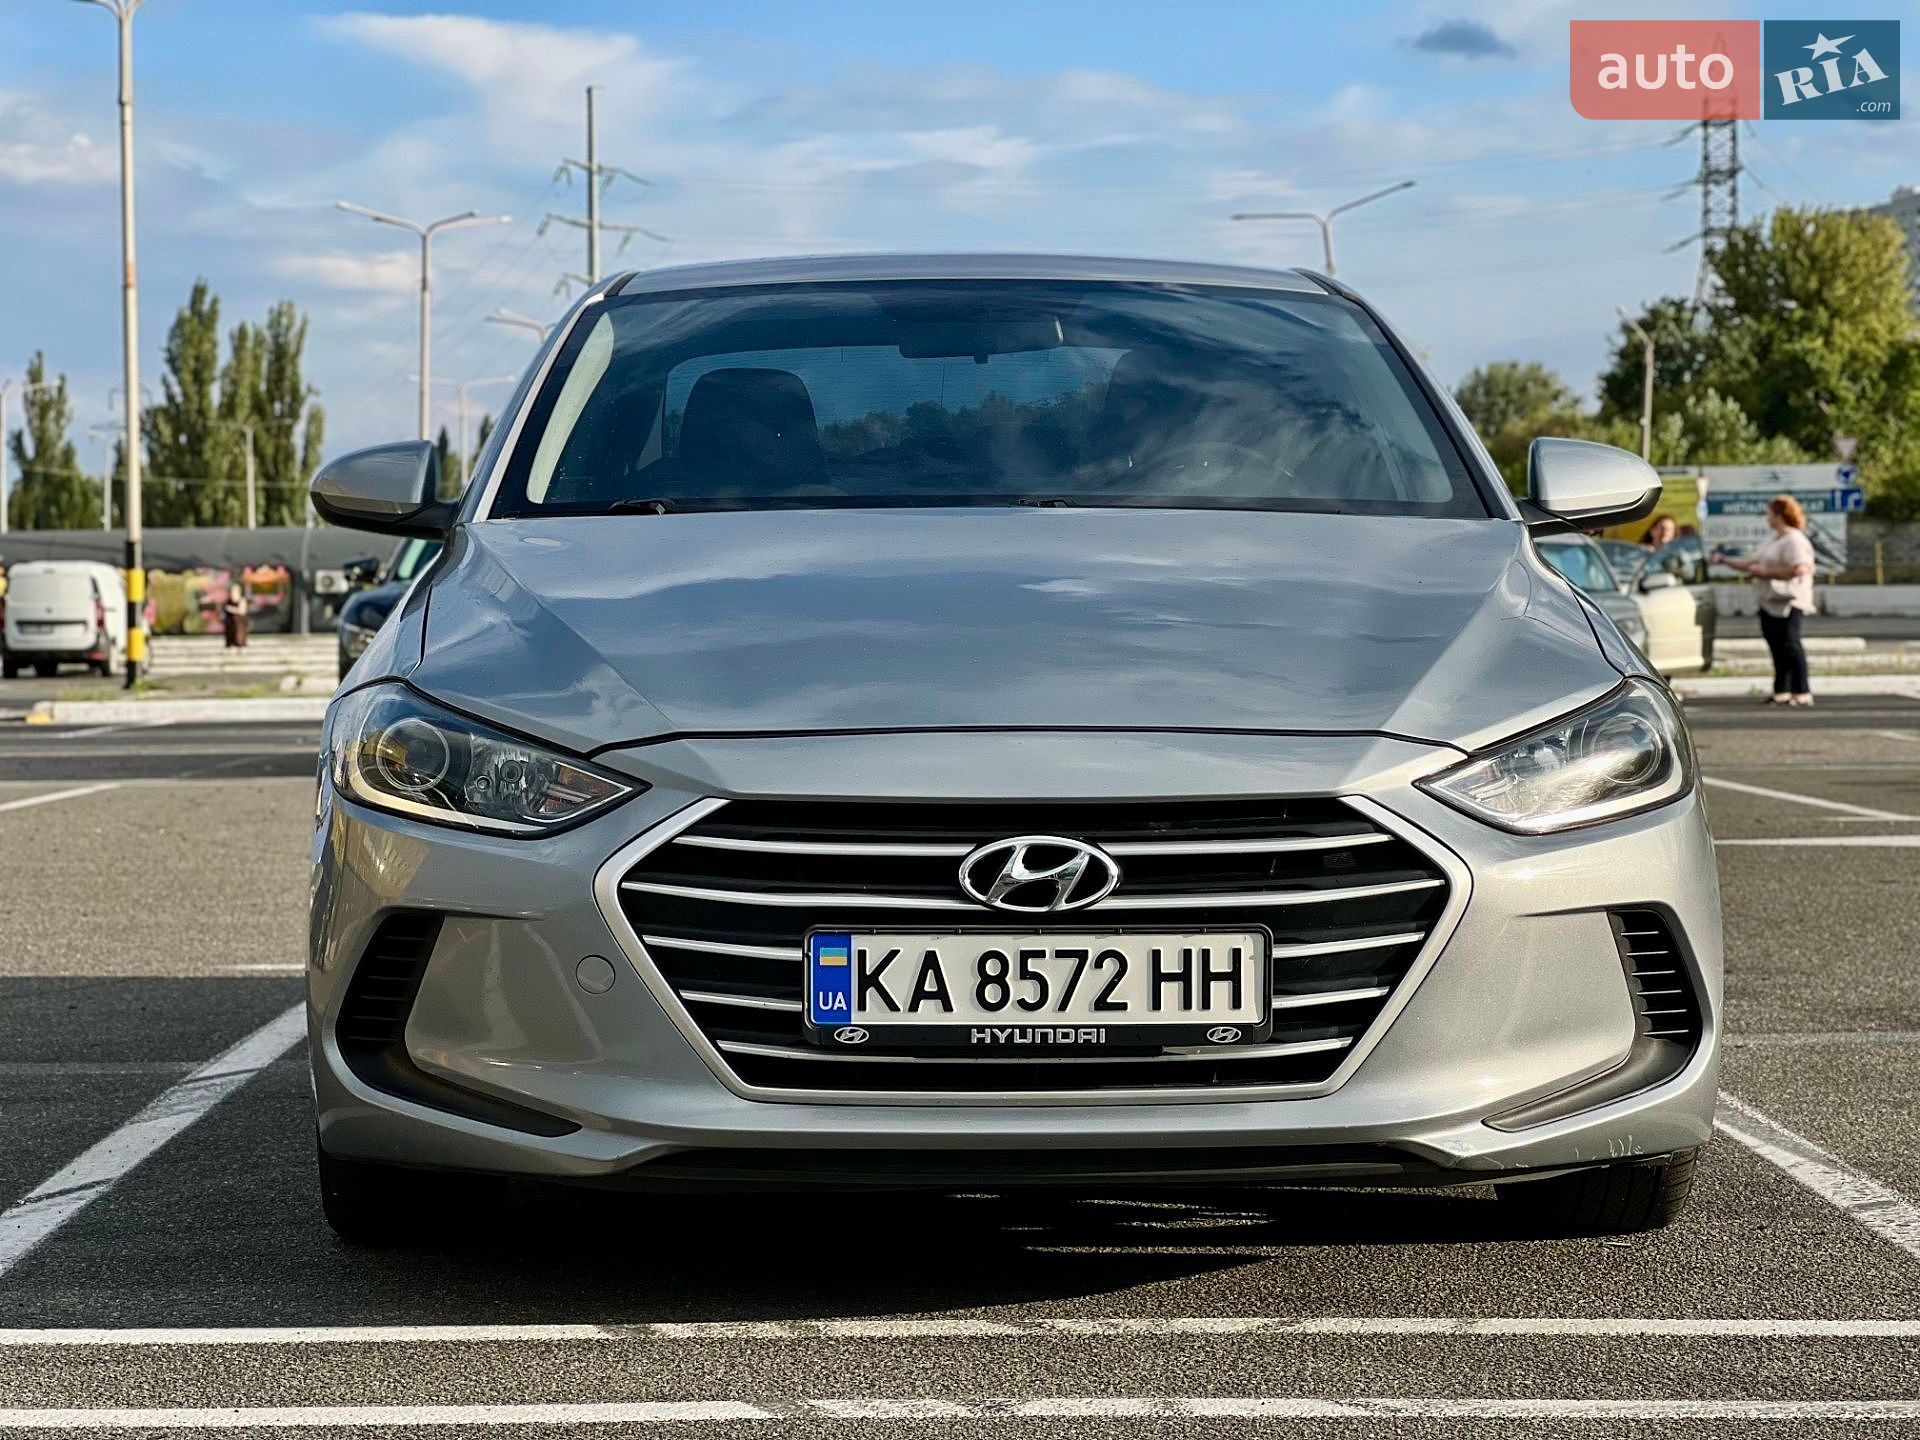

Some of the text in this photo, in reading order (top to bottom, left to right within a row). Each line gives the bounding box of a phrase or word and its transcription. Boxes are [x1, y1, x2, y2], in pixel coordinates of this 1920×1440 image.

[856, 947, 1243, 1013] KA 8572 HH
[819, 991, 848, 1011] UA
[970, 1028, 1106, 1044] HYUNDAI
